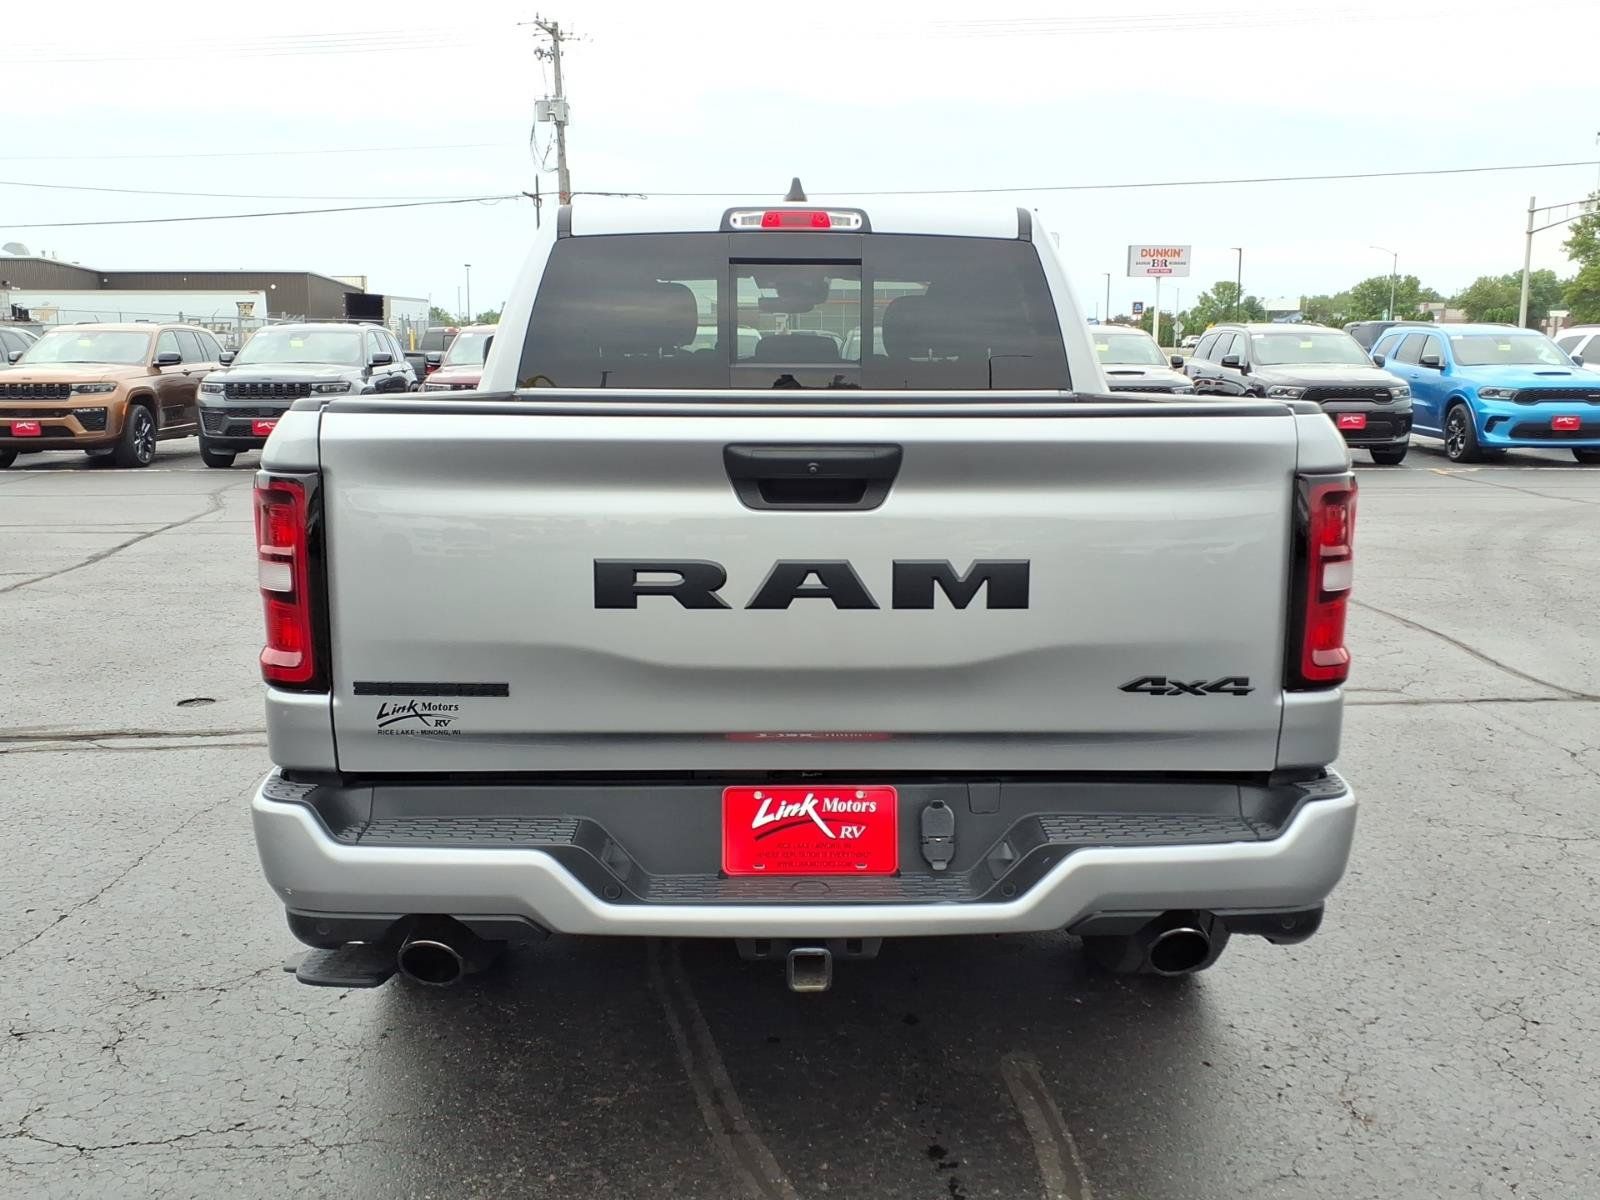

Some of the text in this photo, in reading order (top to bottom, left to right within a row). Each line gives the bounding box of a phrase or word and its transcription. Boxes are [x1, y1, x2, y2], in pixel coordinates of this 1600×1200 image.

[1140, 248, 1184, 258] DUNKIN'
[593, 558, 1031, 610] RAM
[376, 699, 459, 727] Link Motors
[434, 719, 452, 728] RV
[751, 792, 877, 839] Link Motors
[838, 825, 867, 839] RV
